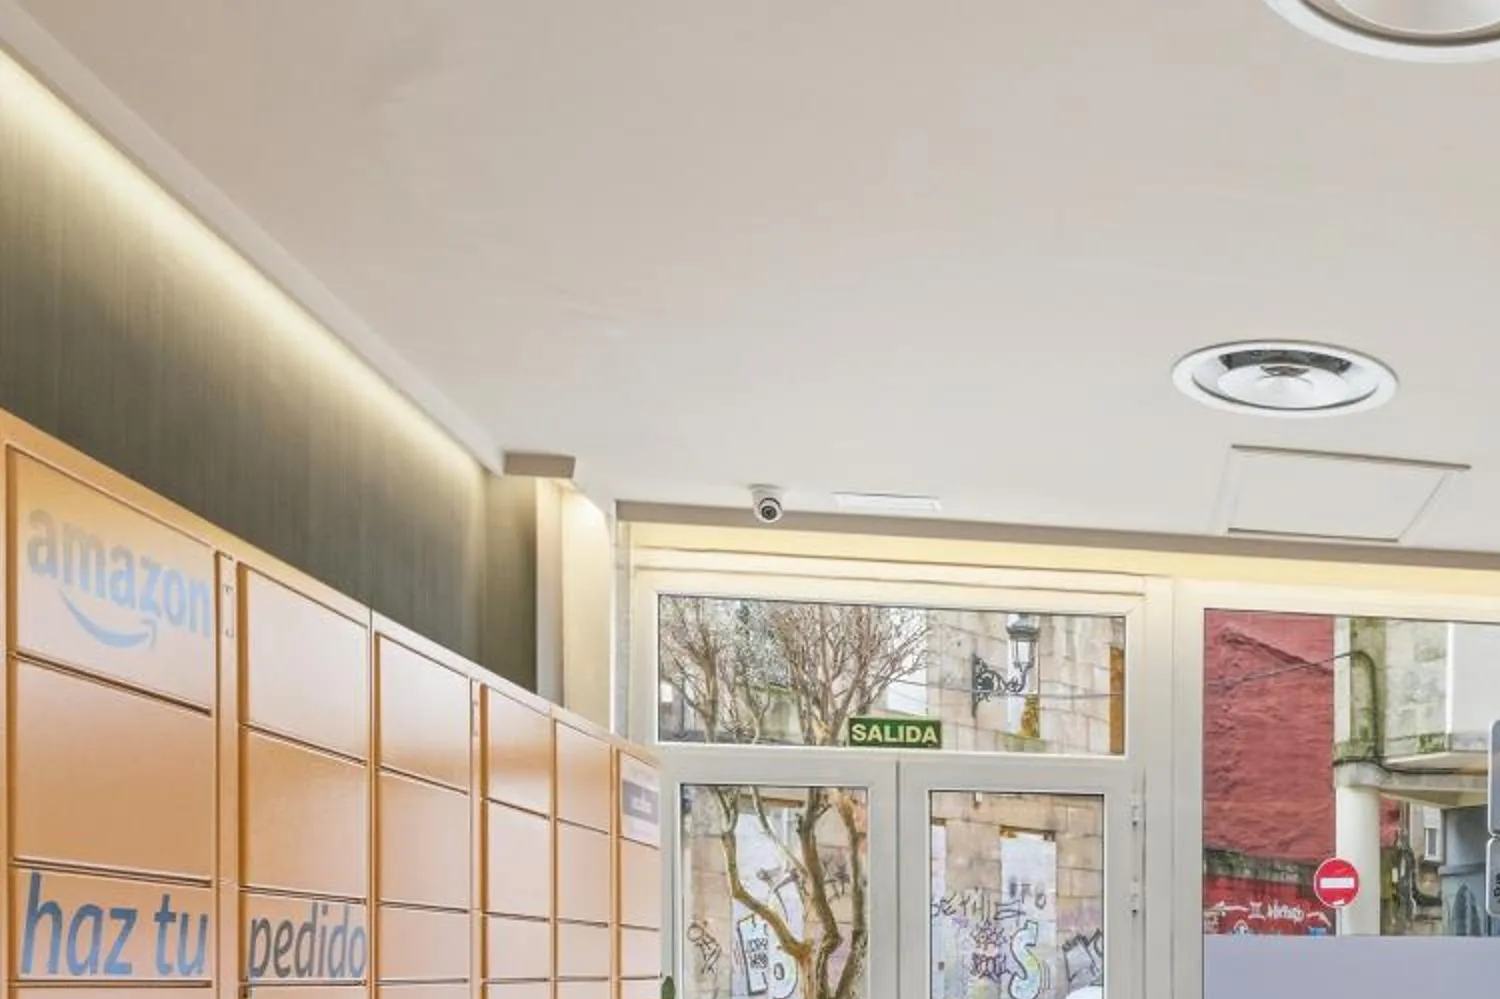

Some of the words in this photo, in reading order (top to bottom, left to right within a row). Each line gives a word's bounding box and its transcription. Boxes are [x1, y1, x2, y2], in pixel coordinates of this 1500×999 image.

[27, 509, 212, 639] amazon
[851, 723, 938, 744] SALIDA
[20, 871, 139, 978] haz
[153, 893, 209, 977] tu
[247, 902, 369, 999] pedido
